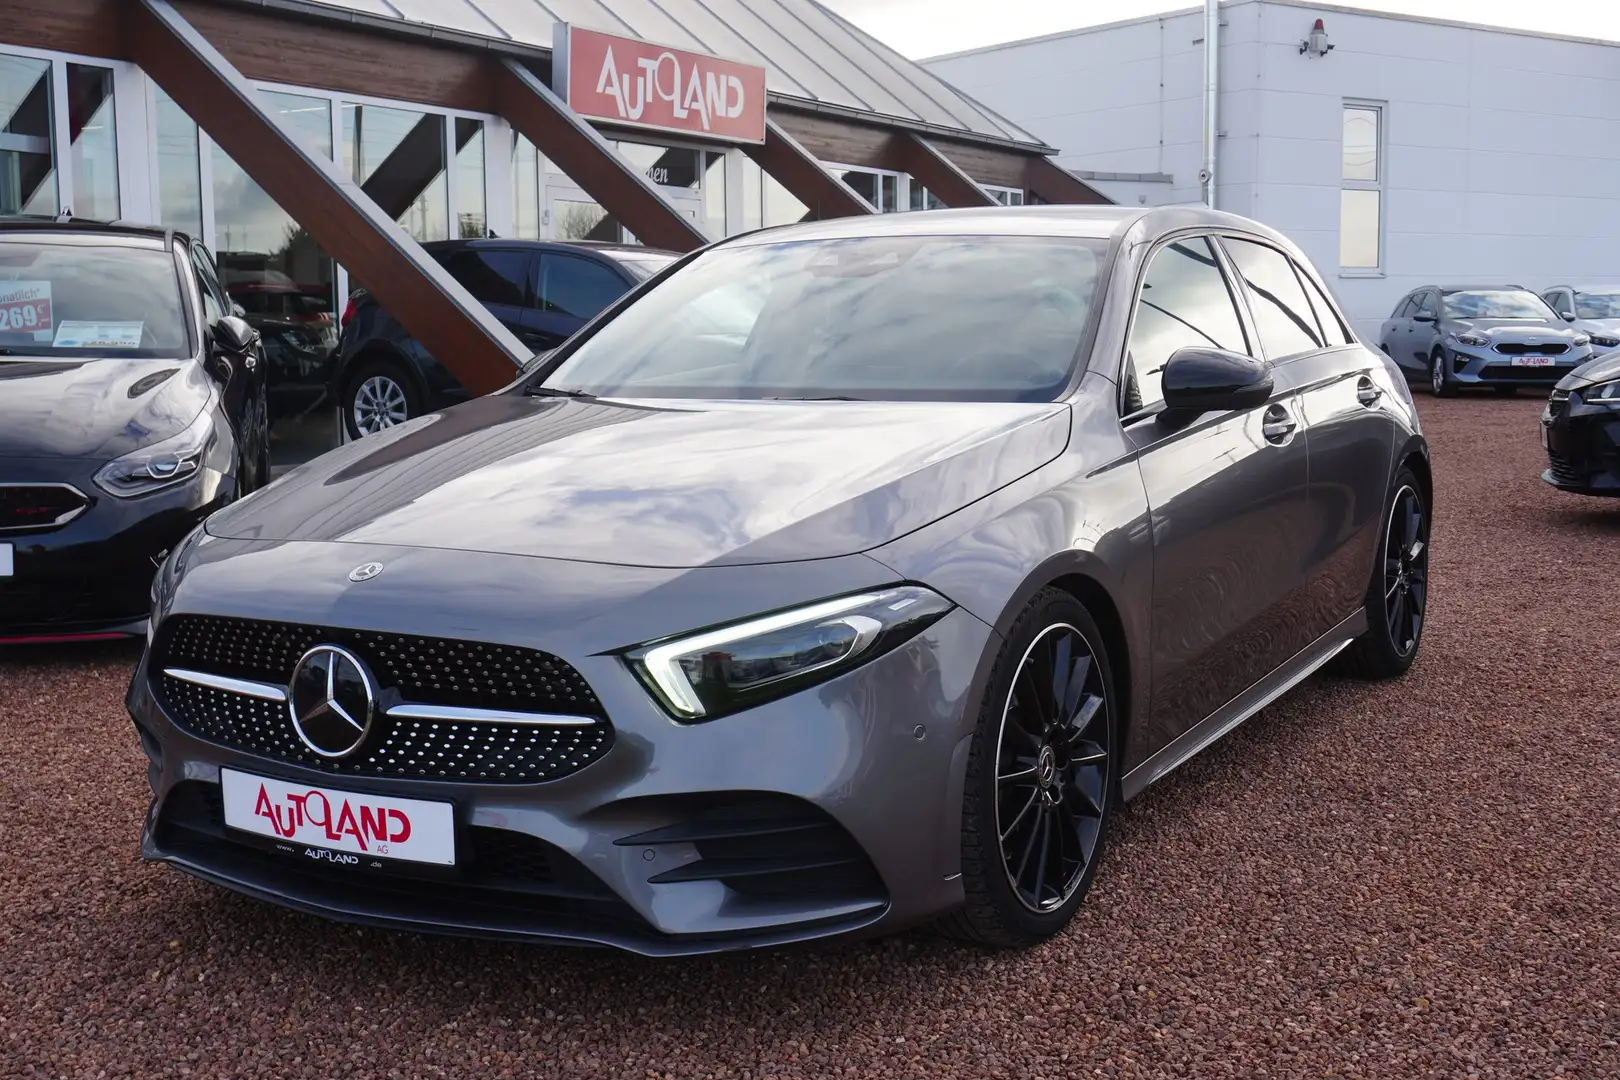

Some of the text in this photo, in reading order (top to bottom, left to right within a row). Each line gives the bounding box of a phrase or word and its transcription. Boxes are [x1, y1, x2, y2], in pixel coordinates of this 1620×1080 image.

[596, 44, 745, 131] AUTOLAND
[254, 782, 412, 851] AUTOLAND
[304, 847, 359, 865] AUTOLAND
[376, 844, 389, 855] AG
